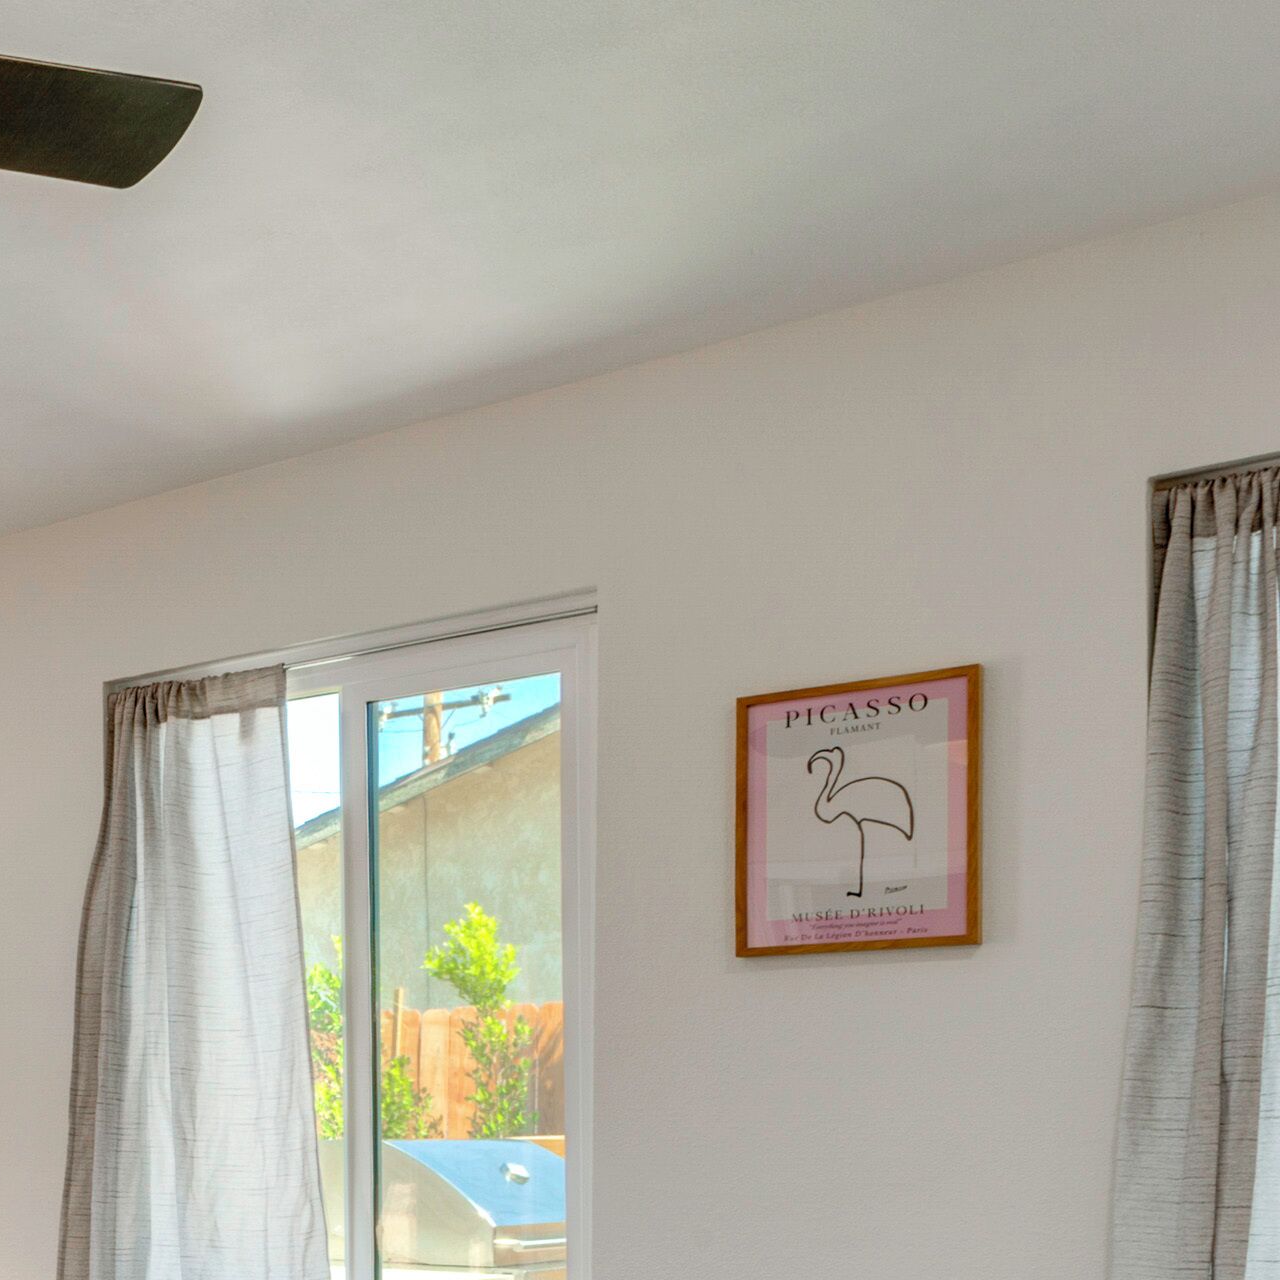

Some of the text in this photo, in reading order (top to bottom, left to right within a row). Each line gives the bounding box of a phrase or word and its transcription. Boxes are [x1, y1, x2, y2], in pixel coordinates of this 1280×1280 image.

[785, 692, 929, 729] PICASSO
[830, 722, 881, 736] FLAMANT
[792, 904, 925, 923] MUSÉE D'RIVOLI
[907, 926, 929, 934] Paris
